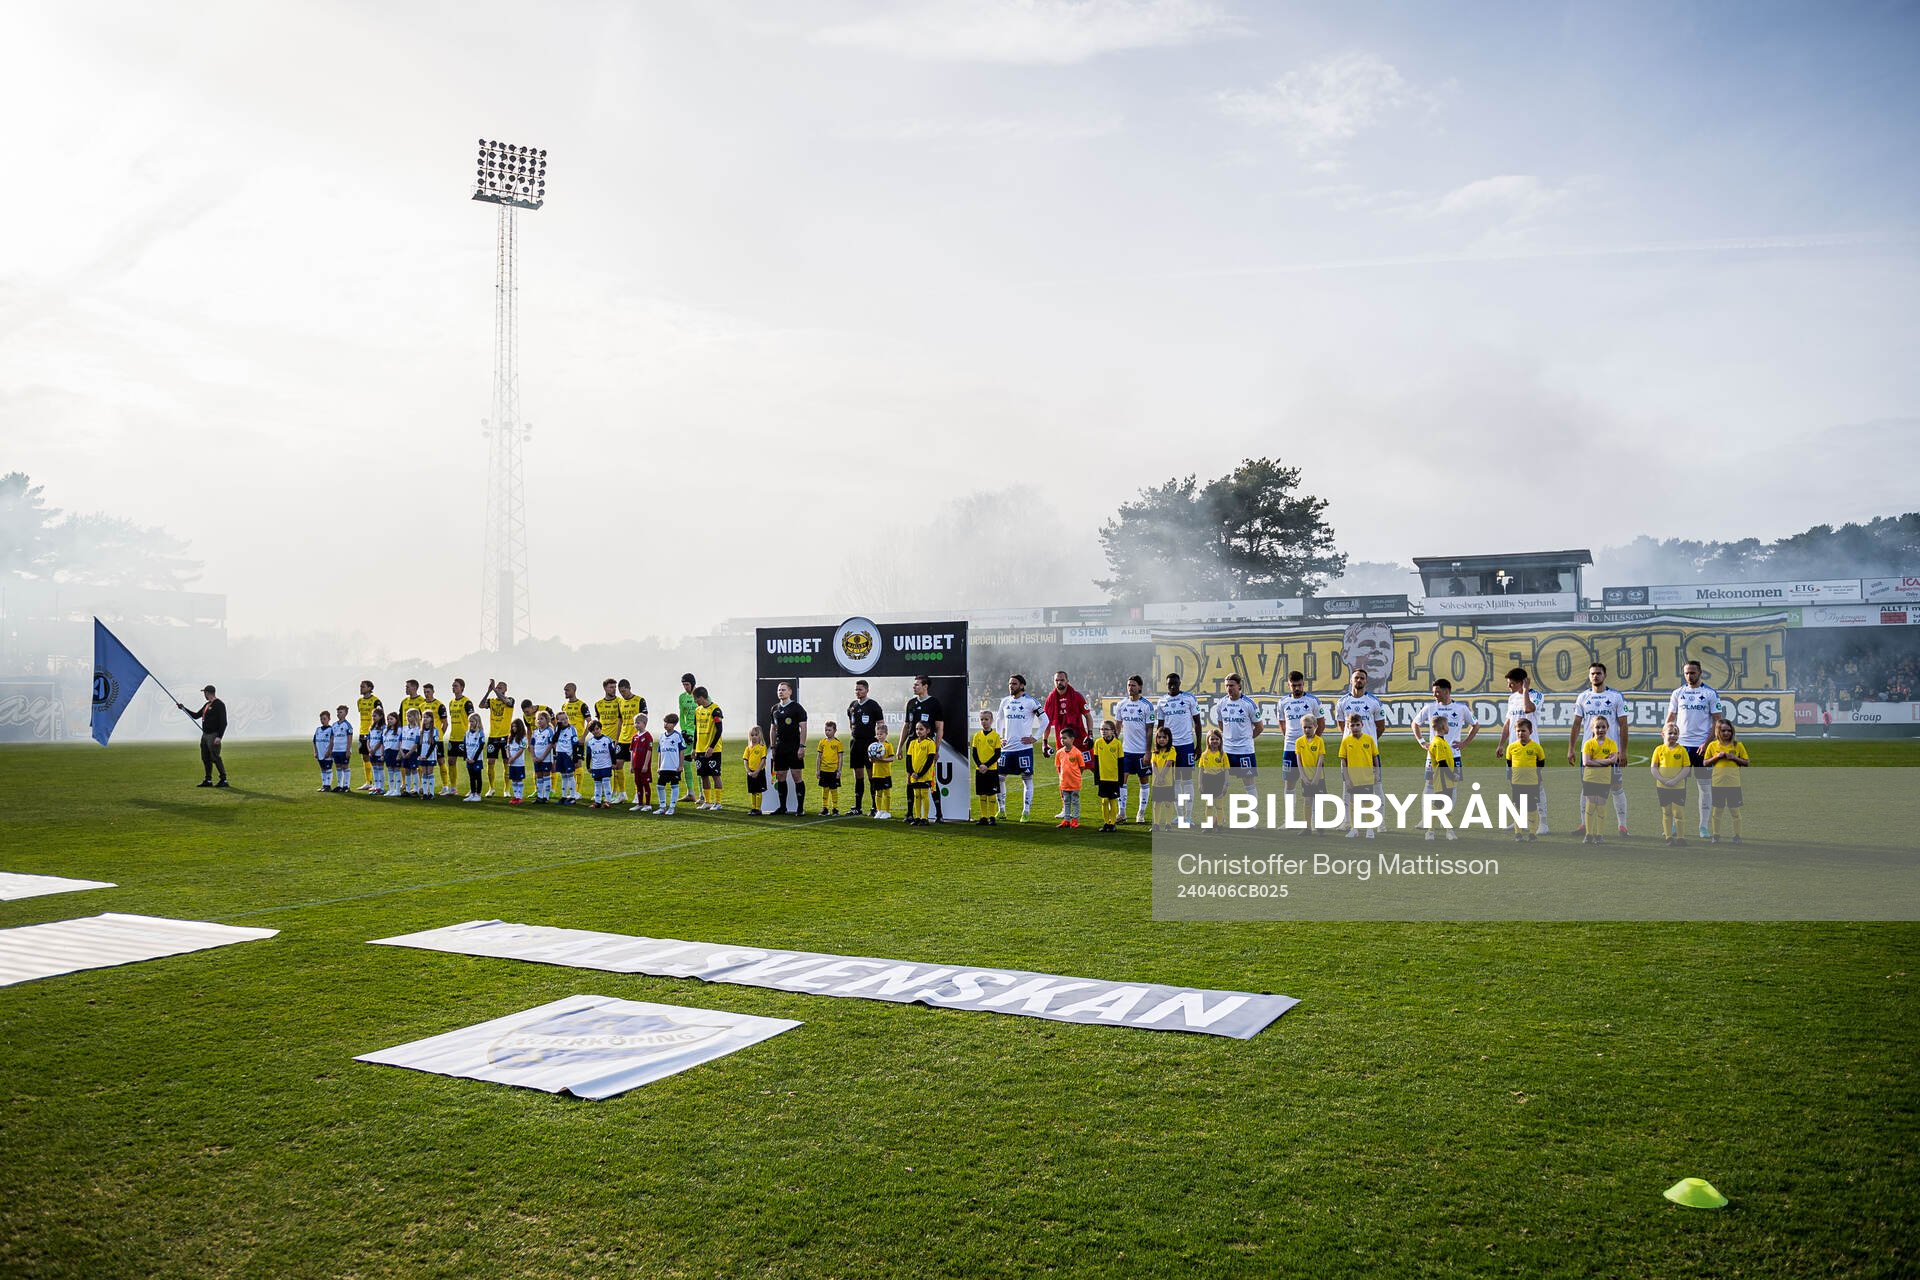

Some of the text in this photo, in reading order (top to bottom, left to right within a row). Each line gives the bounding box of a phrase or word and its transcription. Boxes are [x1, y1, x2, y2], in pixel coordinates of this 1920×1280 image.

[1695, 588, 1783, 600] Mekonomen
[1795, 584, 1815, 592] ETG
[1517, 598, 1558, 609] Sparbank
[1591, 614, 1601, 622] O.
[1078, 627, 1109, 637] STENA
[766, 638, 822, 654] UNIBET
[893, 634, 955, 651] UNIBET
[1153, 637, 1349, 694] DAVID
[1851, 711, 1882, 723] Group
[936, 761, 953, 785] U
